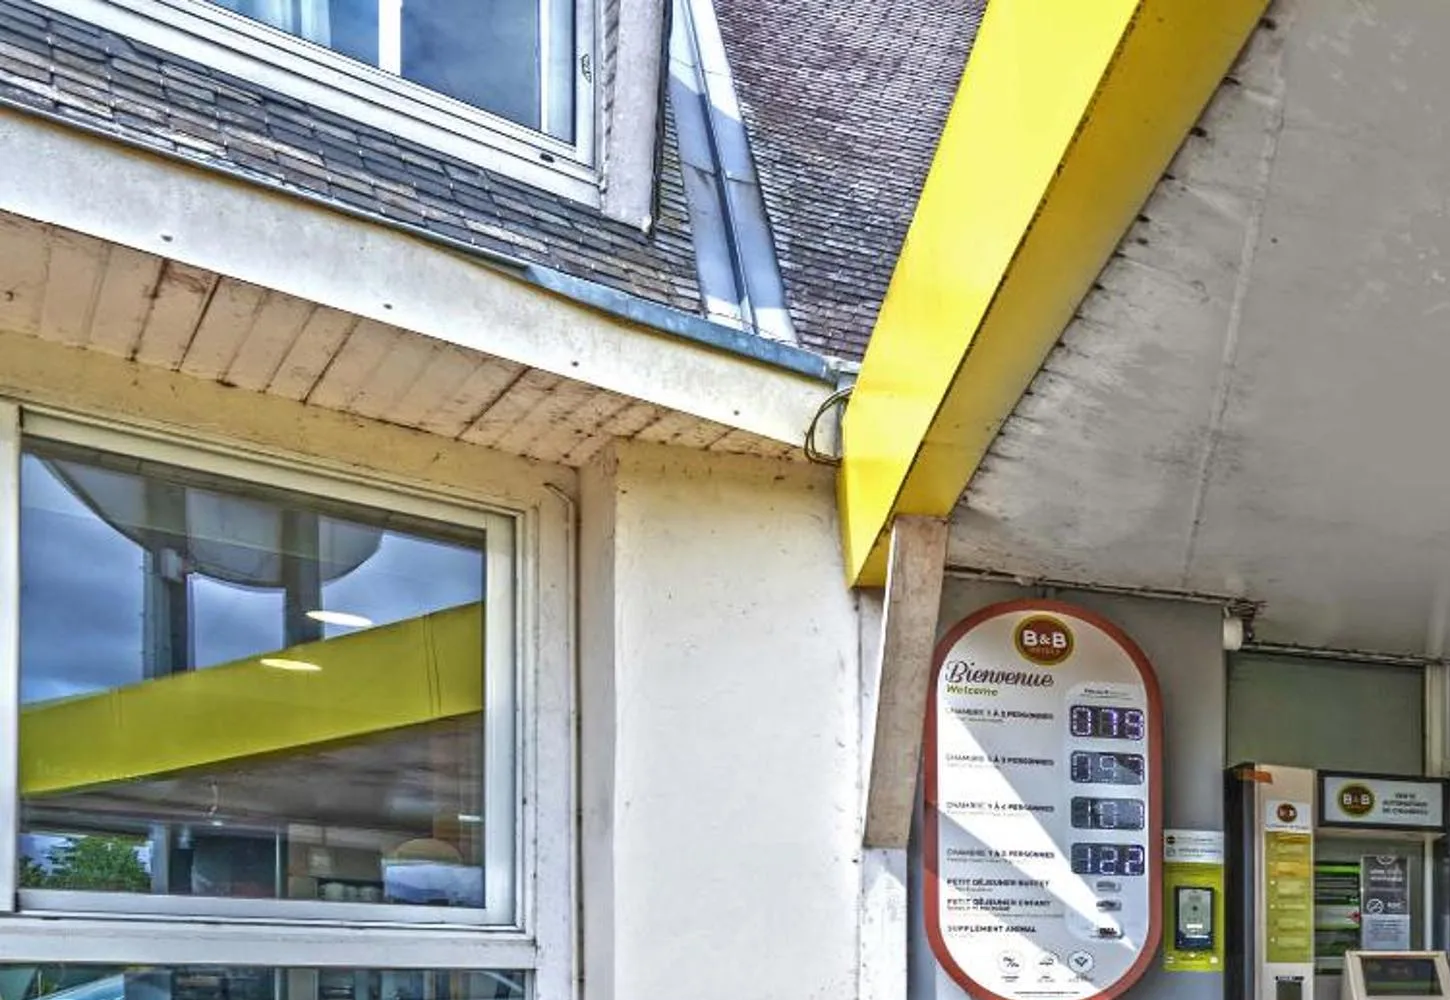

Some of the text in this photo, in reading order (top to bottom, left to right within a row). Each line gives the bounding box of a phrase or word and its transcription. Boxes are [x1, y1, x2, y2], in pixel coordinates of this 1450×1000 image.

[1023, 630, 1067, 648] B&B
[945, 660, 1054, 687] Bienvenue
[946, 683, 998, 696] Welcome
[1007, 757, 1055, 766] PERSONNES
[1086, 846, 1143, 875] 122
[946, 878, 971, 886] PETIT
